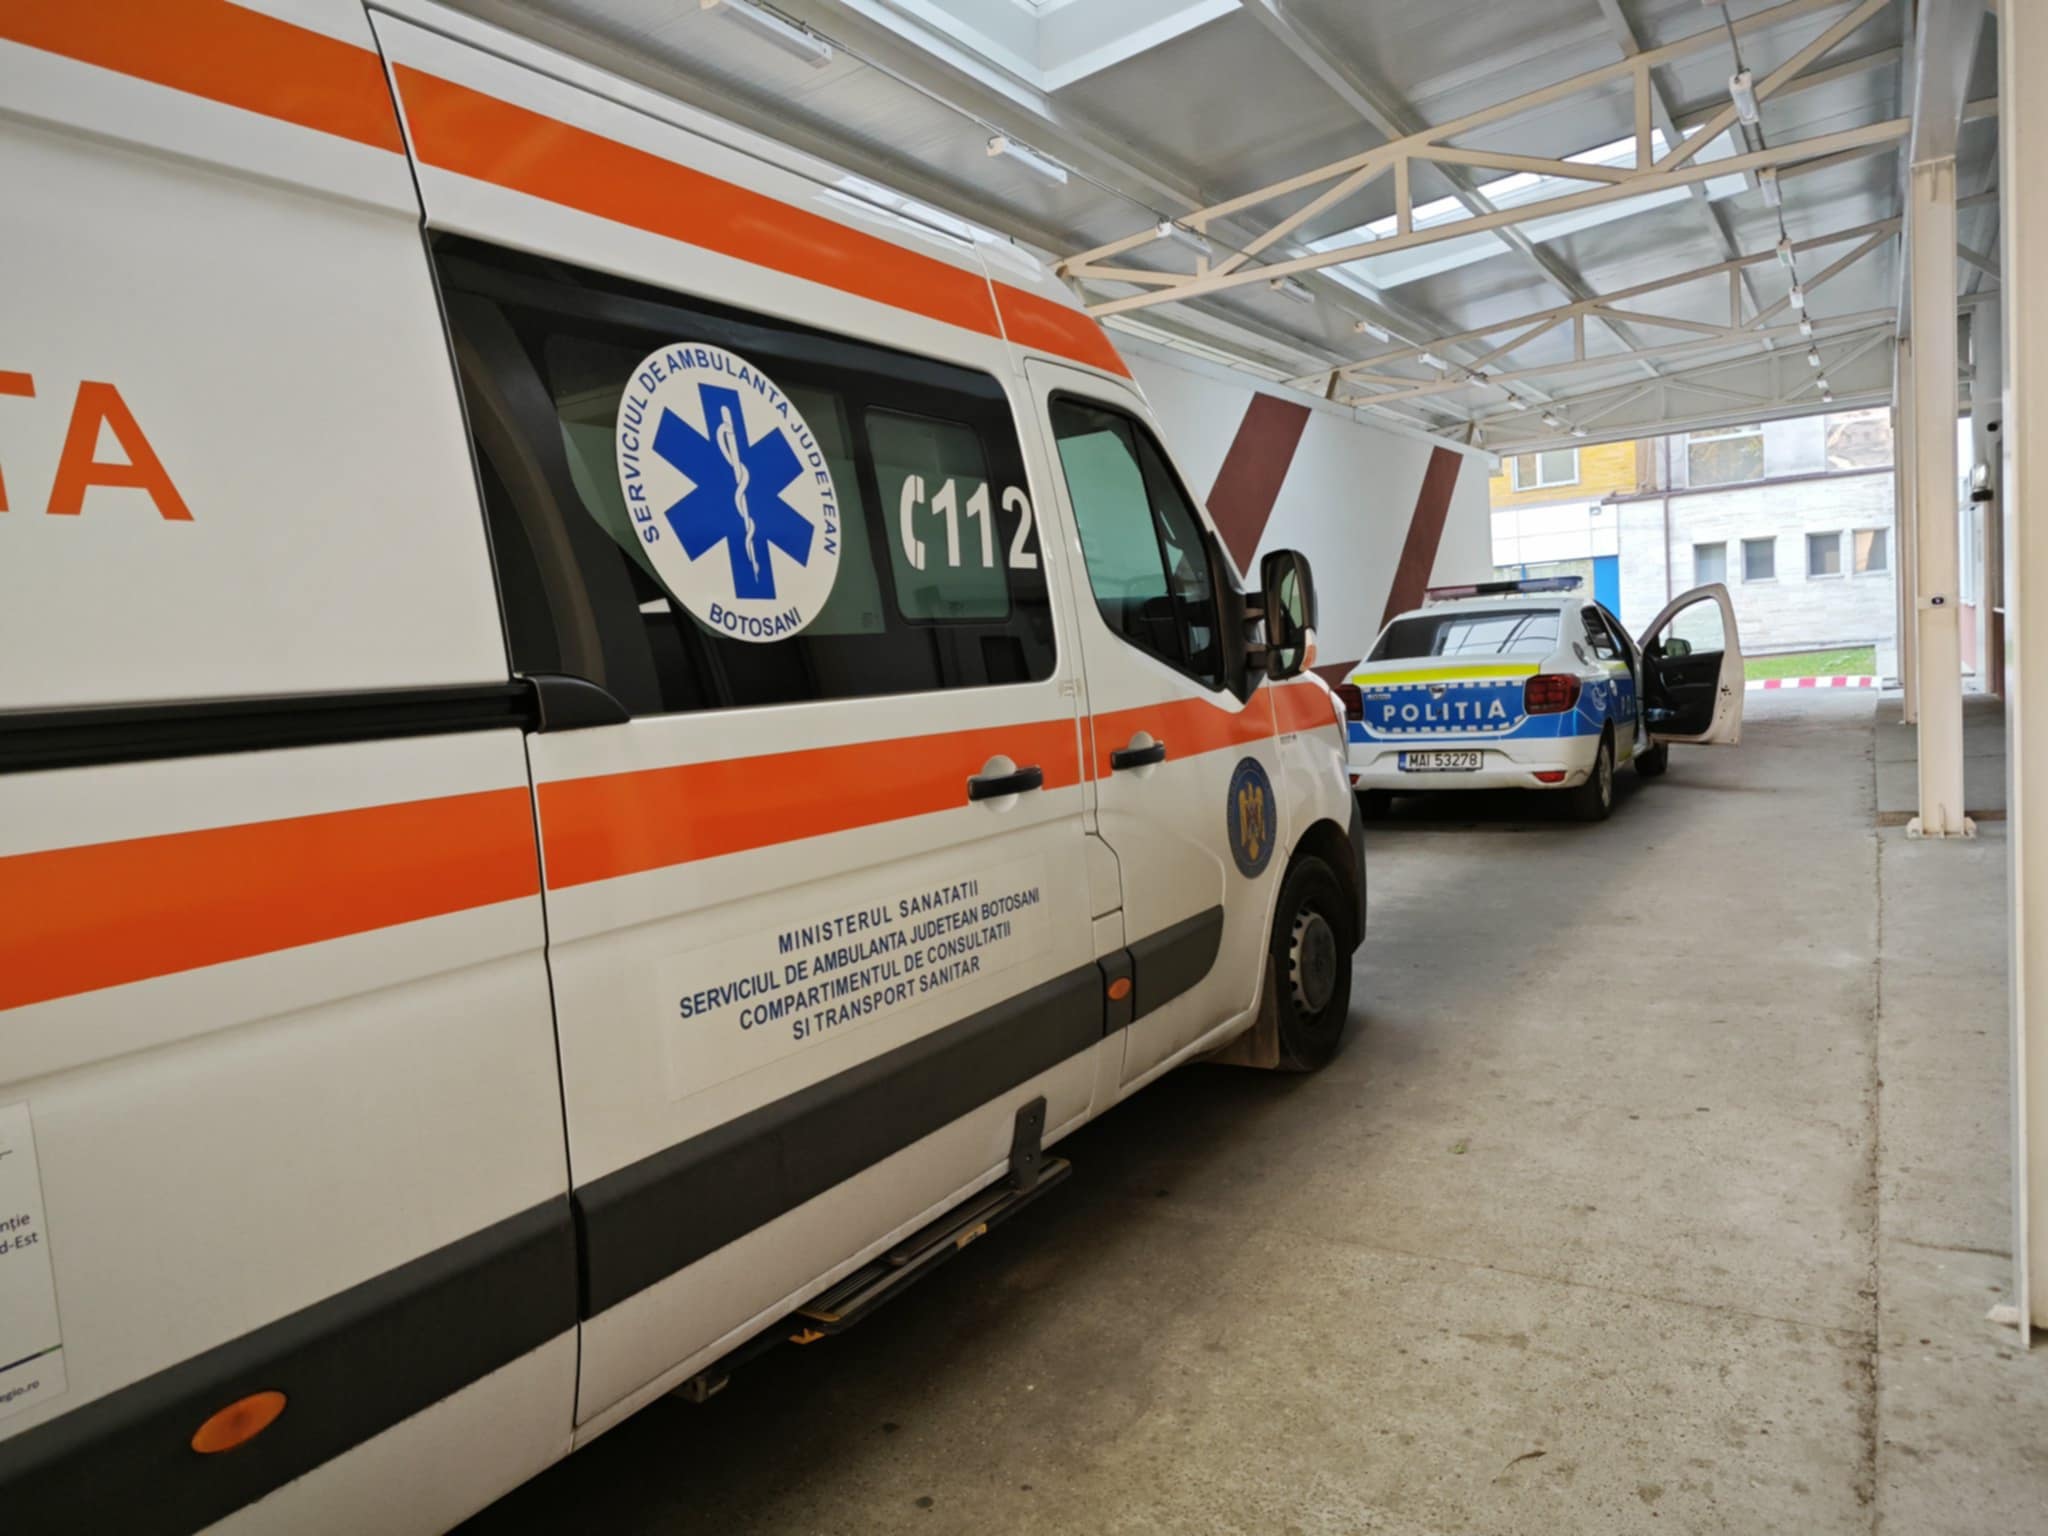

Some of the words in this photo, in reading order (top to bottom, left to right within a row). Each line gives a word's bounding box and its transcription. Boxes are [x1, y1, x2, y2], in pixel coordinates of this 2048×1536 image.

[639, 361, 667, 393] DE
[667, 348, 789, 420] AMBULANTA
[622, 396, 660, 543] SERVICIUL
[791, 422, 837, 556] JUDETEAN
[709, 603, 801, 637] BOTOSANI
[1383, 699, 1507, 722] POLITIA
[1409, 753, 1430, 767] MAI
[1435, 753, 1478, 767] 53278
[679, 971, 780, 1019] SERVICIUL
[784, 963, 808, 985] DE
[812, 930, 908, 976] AMBULANTA
[910, 911, 979, 945] JUDETEAN
[981, 888, 1040, 921] BOTOSANI
[778, 906, 893, 954] MINISTERUL
[899, 880, 979, 919] SANATATII
[739, 961, 900, 1030] COMPARTIMENTUL
[904, 951, 924, 974] DE
[927, 921, 1012, 965] CONSULTATII
[793, 1018, 810, 1040] SI
[814, 981, 916, 1032] TRANSPORT
[919, 956, 981, 992] SANITAR
